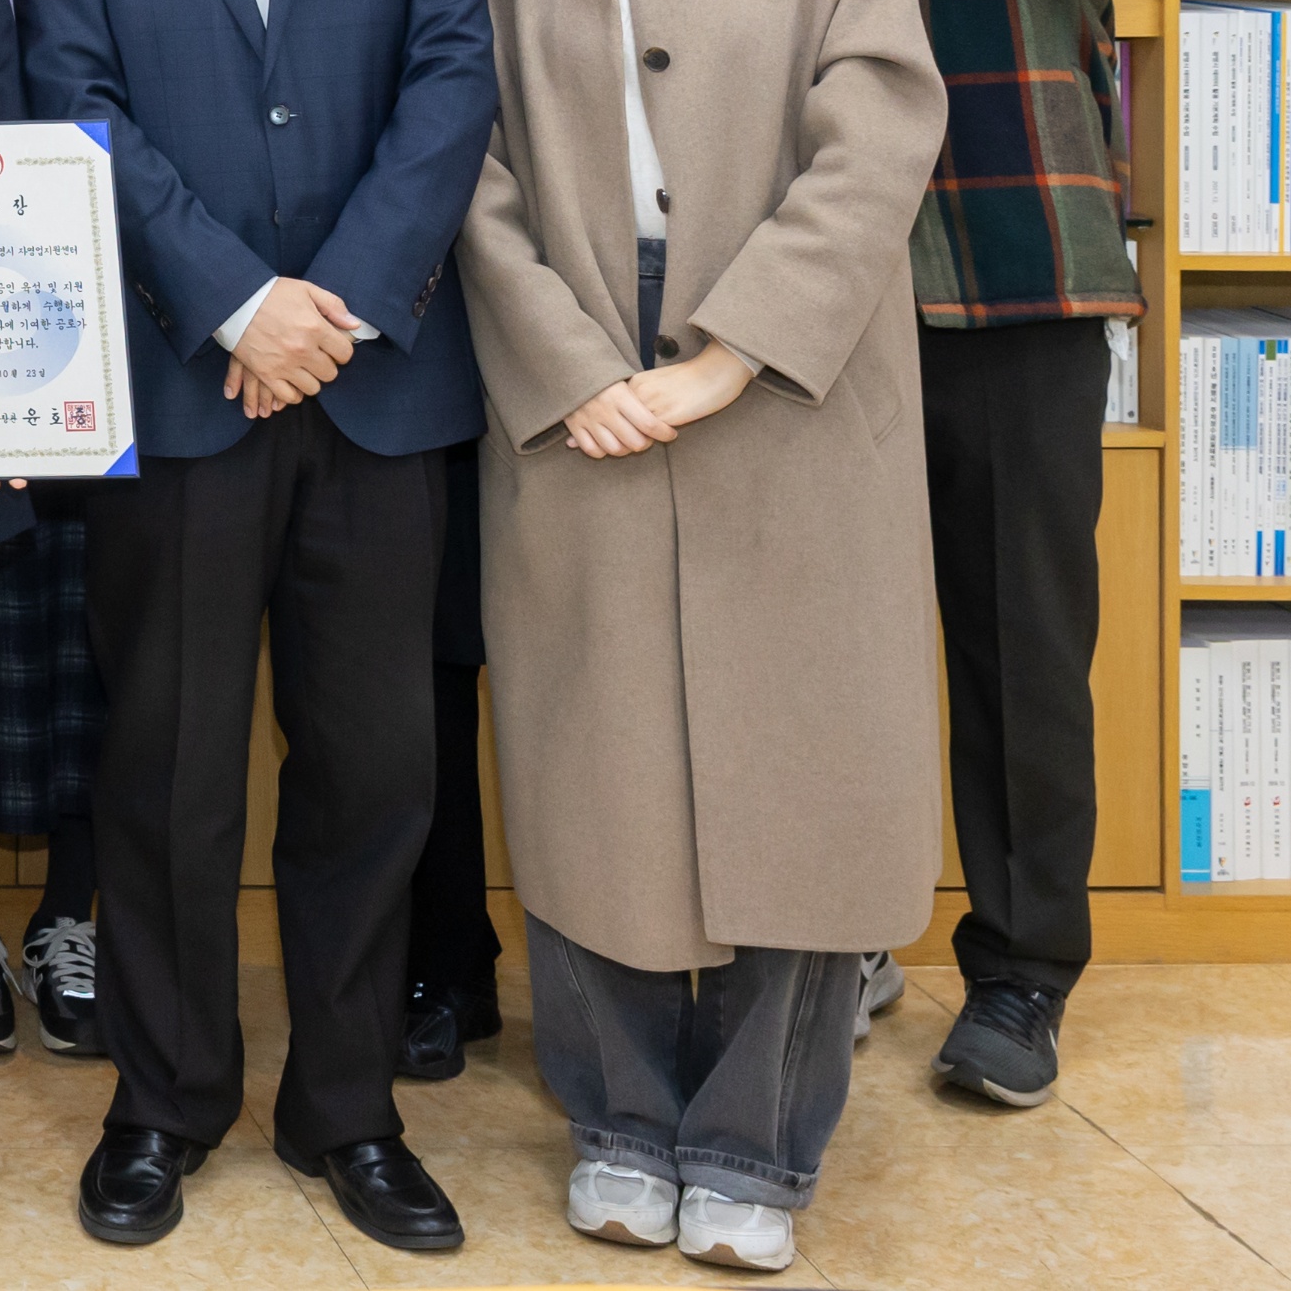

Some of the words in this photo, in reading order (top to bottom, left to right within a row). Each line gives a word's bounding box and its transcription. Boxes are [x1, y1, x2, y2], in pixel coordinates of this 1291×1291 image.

[18, 244, 78, 257] 자영업지원센터
[20, 281, 41, 294] 육성
[48, 281, 57, 294] 및
[63, 280, 83, 293] 지원
[42, 299, 85, 312] 수행하여
[20, 318, 52, 331] 기여한
[55, 317, 88, 331] 공로가
